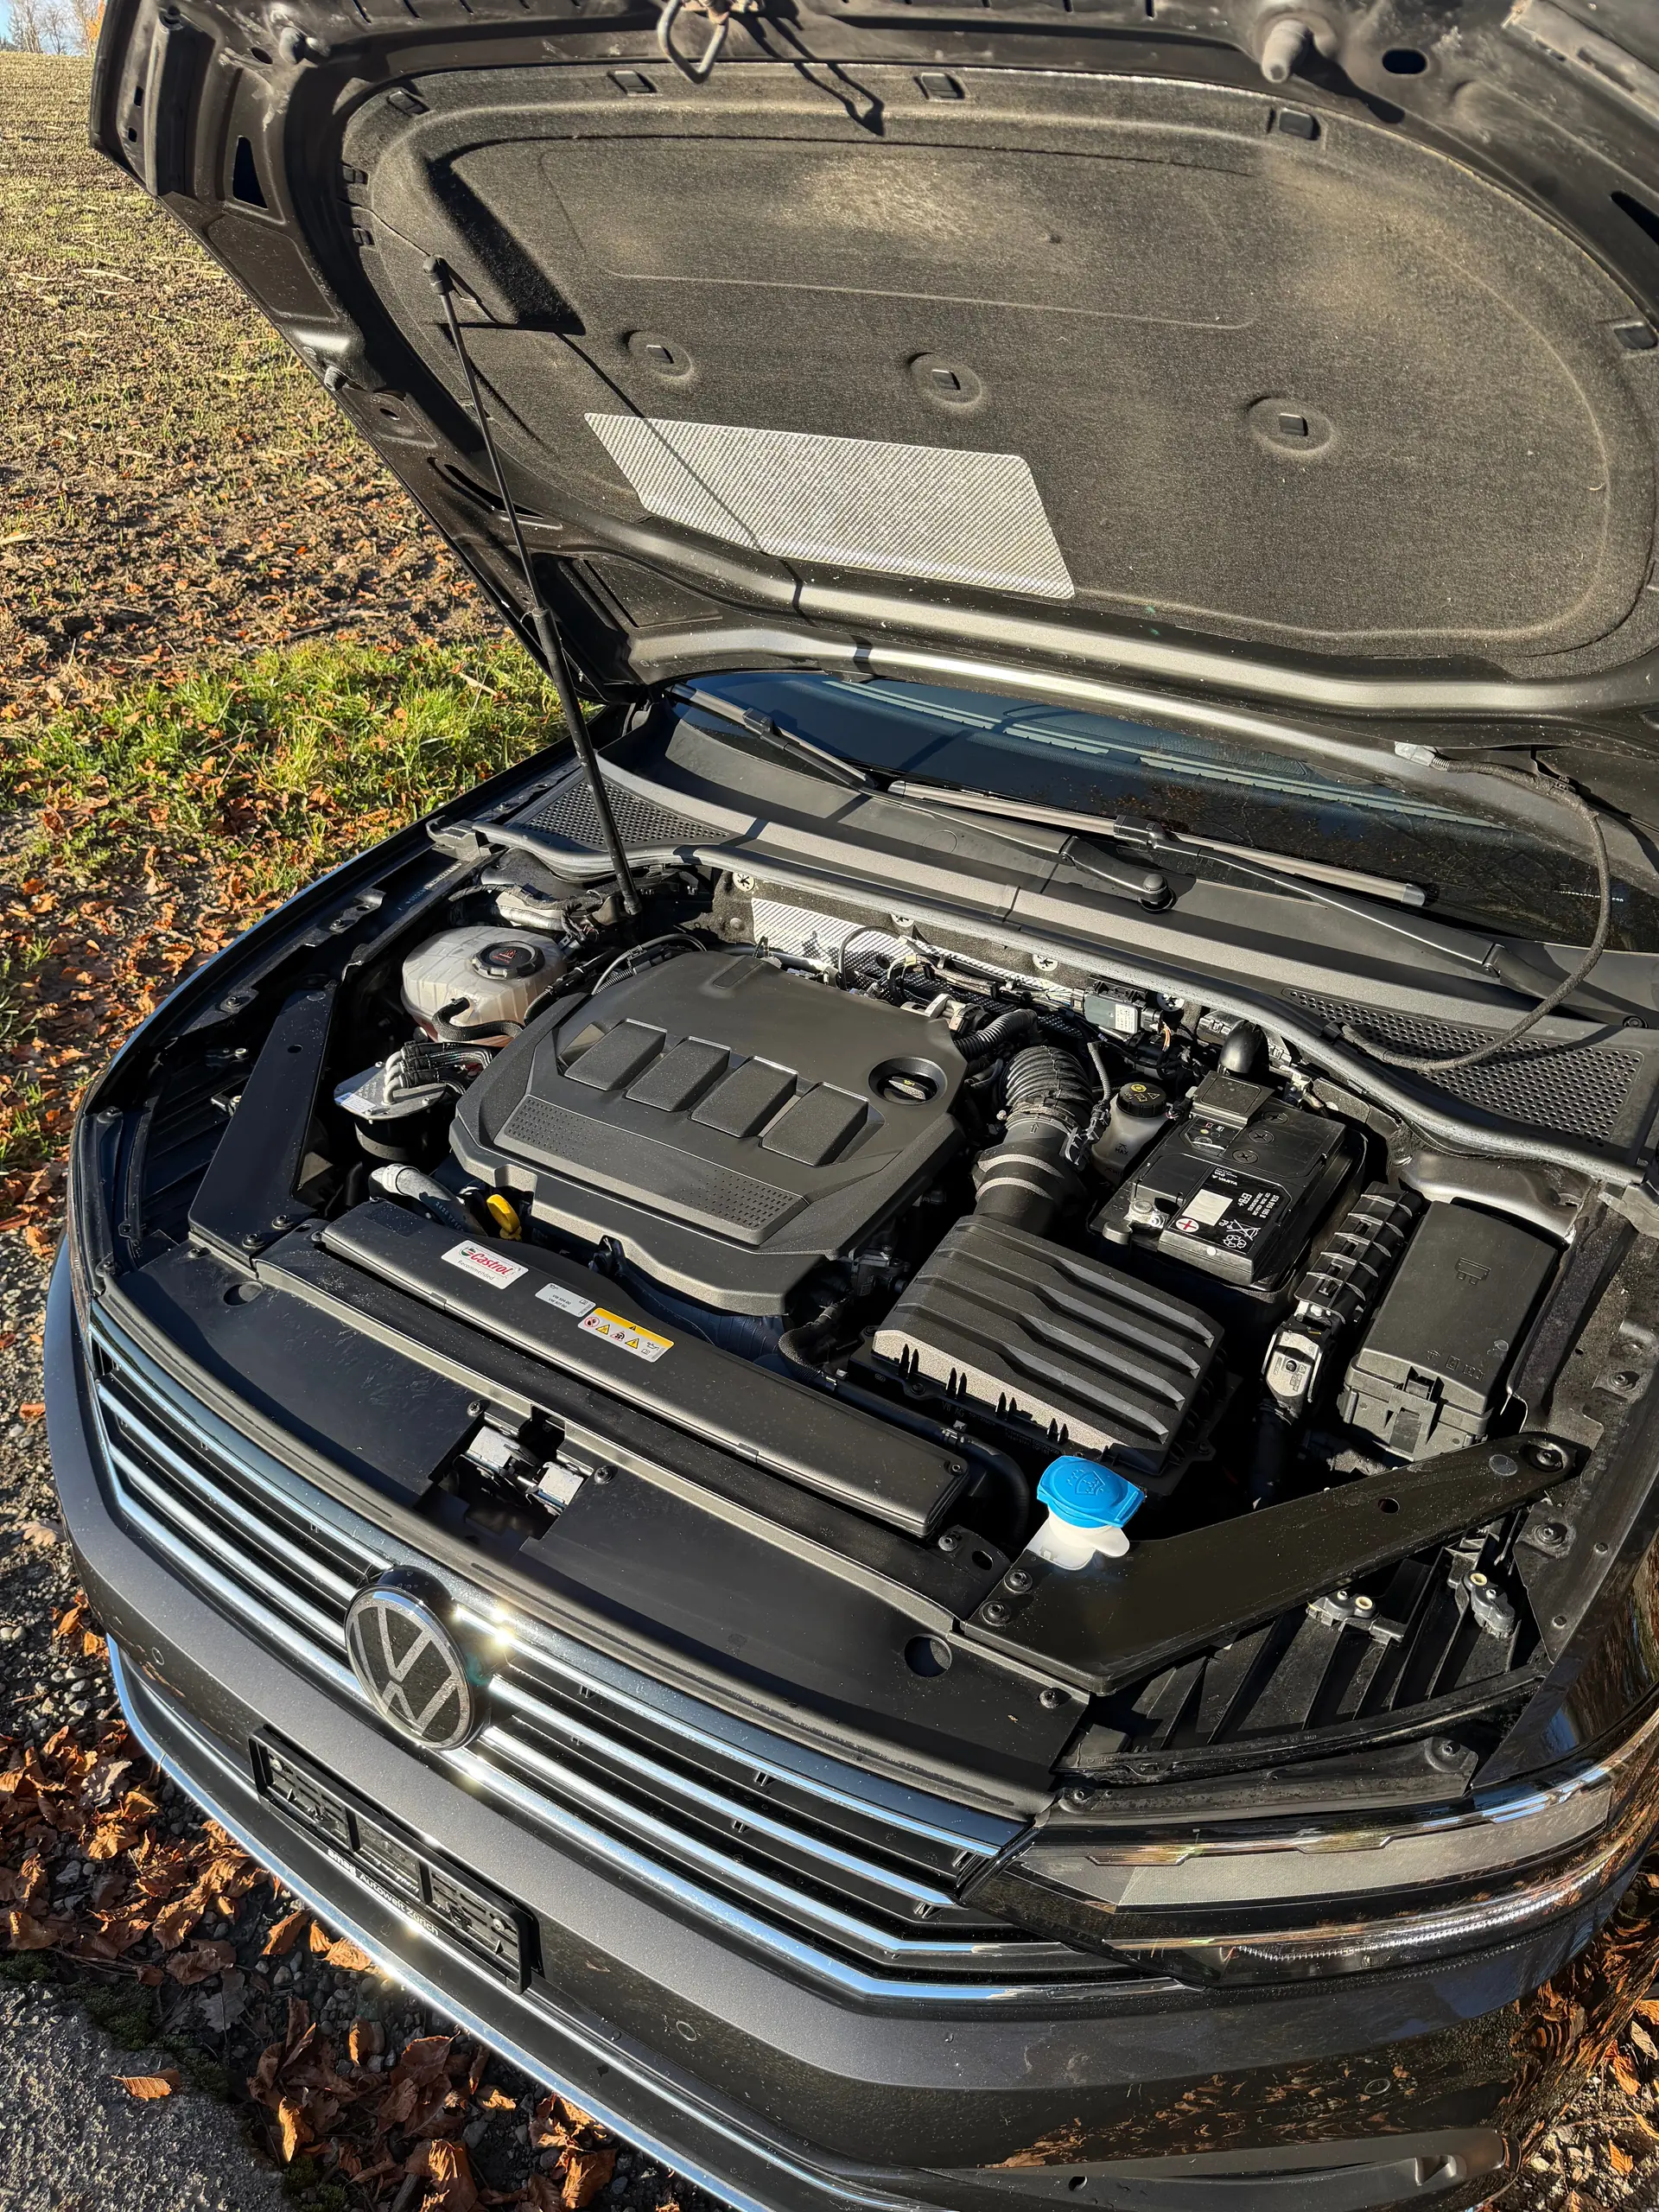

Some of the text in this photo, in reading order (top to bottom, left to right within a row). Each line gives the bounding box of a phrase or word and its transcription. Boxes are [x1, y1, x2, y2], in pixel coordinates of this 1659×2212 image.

[1217, 1176, 1238, 1185] VARTA
[1237, 1192, 1253, 1207] EFB+
[457, 1260, 495, 1281] Recommended
[470, 1252, 513, 1275] Castrol
[327, 1848, 439, 1935] amag Autowelt Zürich
